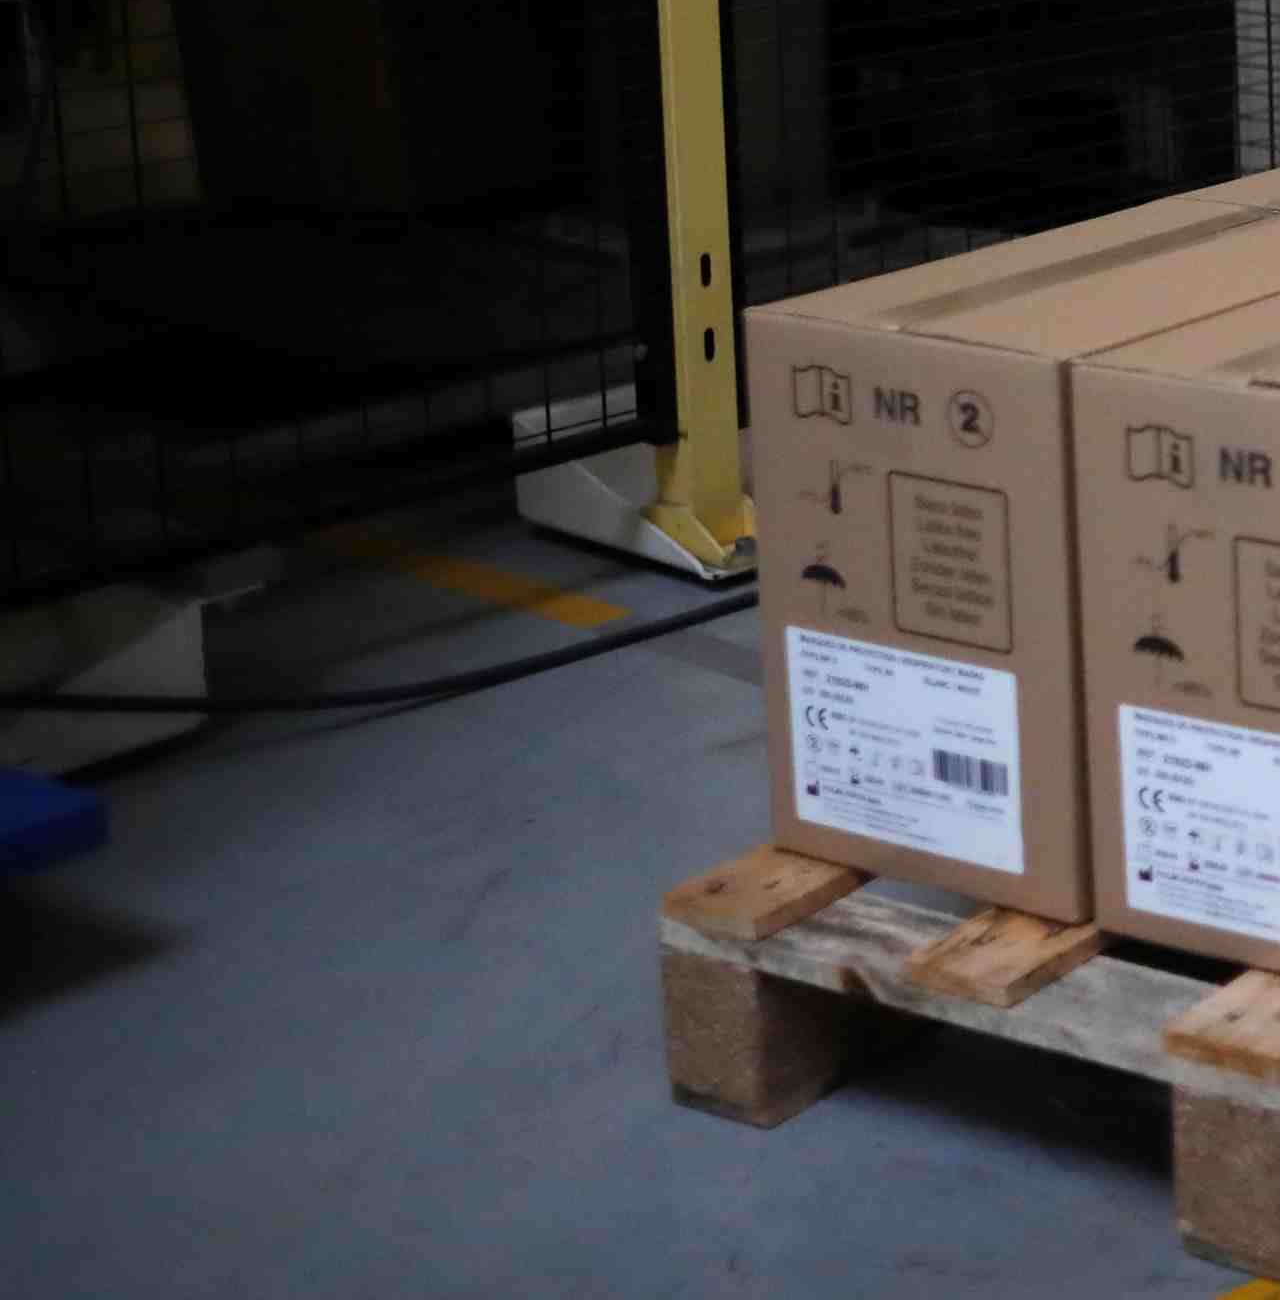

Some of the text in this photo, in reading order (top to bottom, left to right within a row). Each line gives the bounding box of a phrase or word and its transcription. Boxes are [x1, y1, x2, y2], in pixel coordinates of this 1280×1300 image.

[874, 386, 980, 433] NR 2
[1219, 446, 1274, 489] NR
